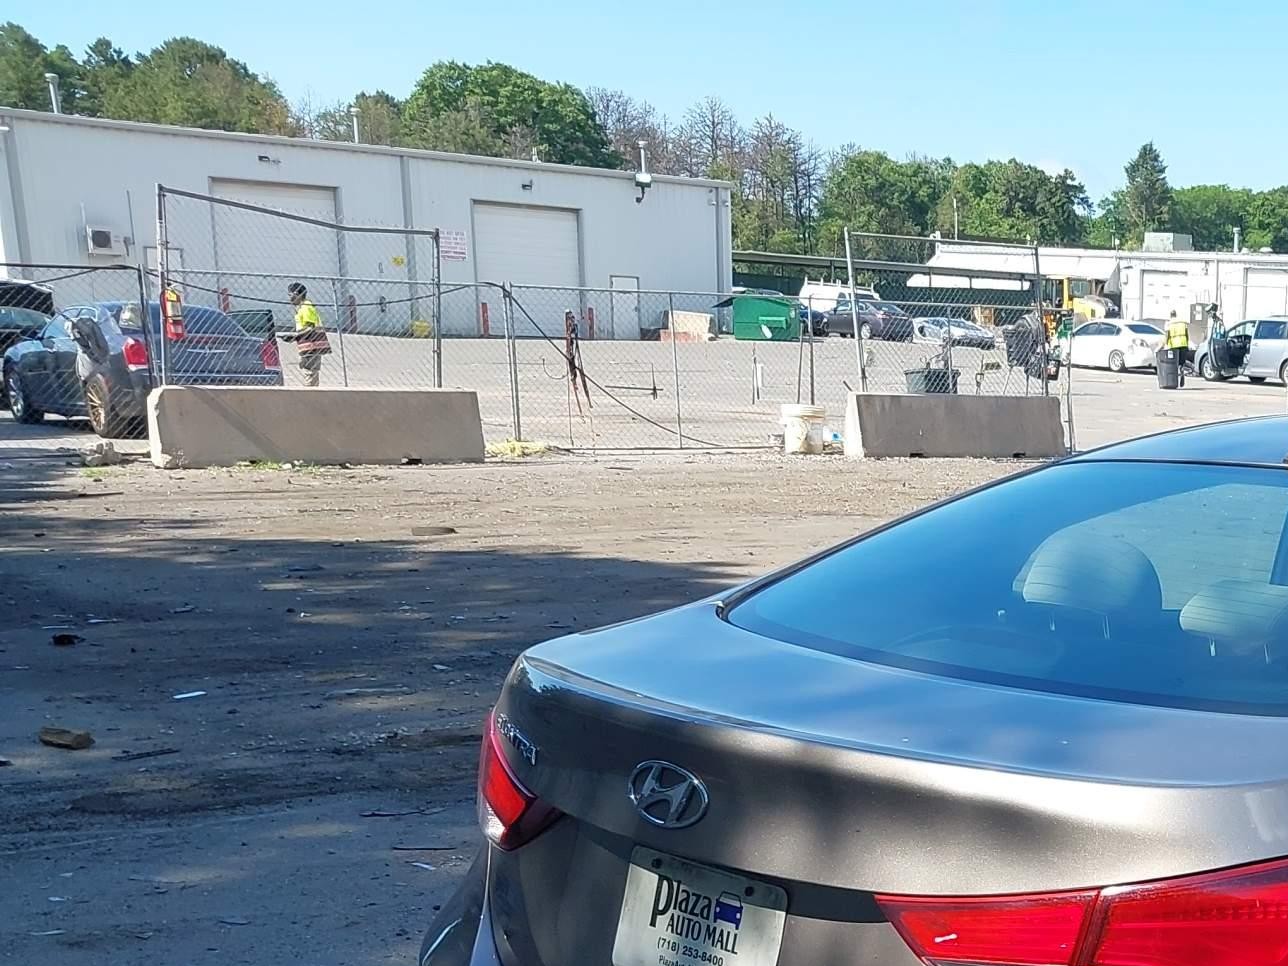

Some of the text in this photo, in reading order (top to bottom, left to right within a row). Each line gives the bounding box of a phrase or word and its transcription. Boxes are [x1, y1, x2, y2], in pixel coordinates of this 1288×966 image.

[657, 936, 680, 955] (718)
[665, 913, 738, 954] AUTO MALL
